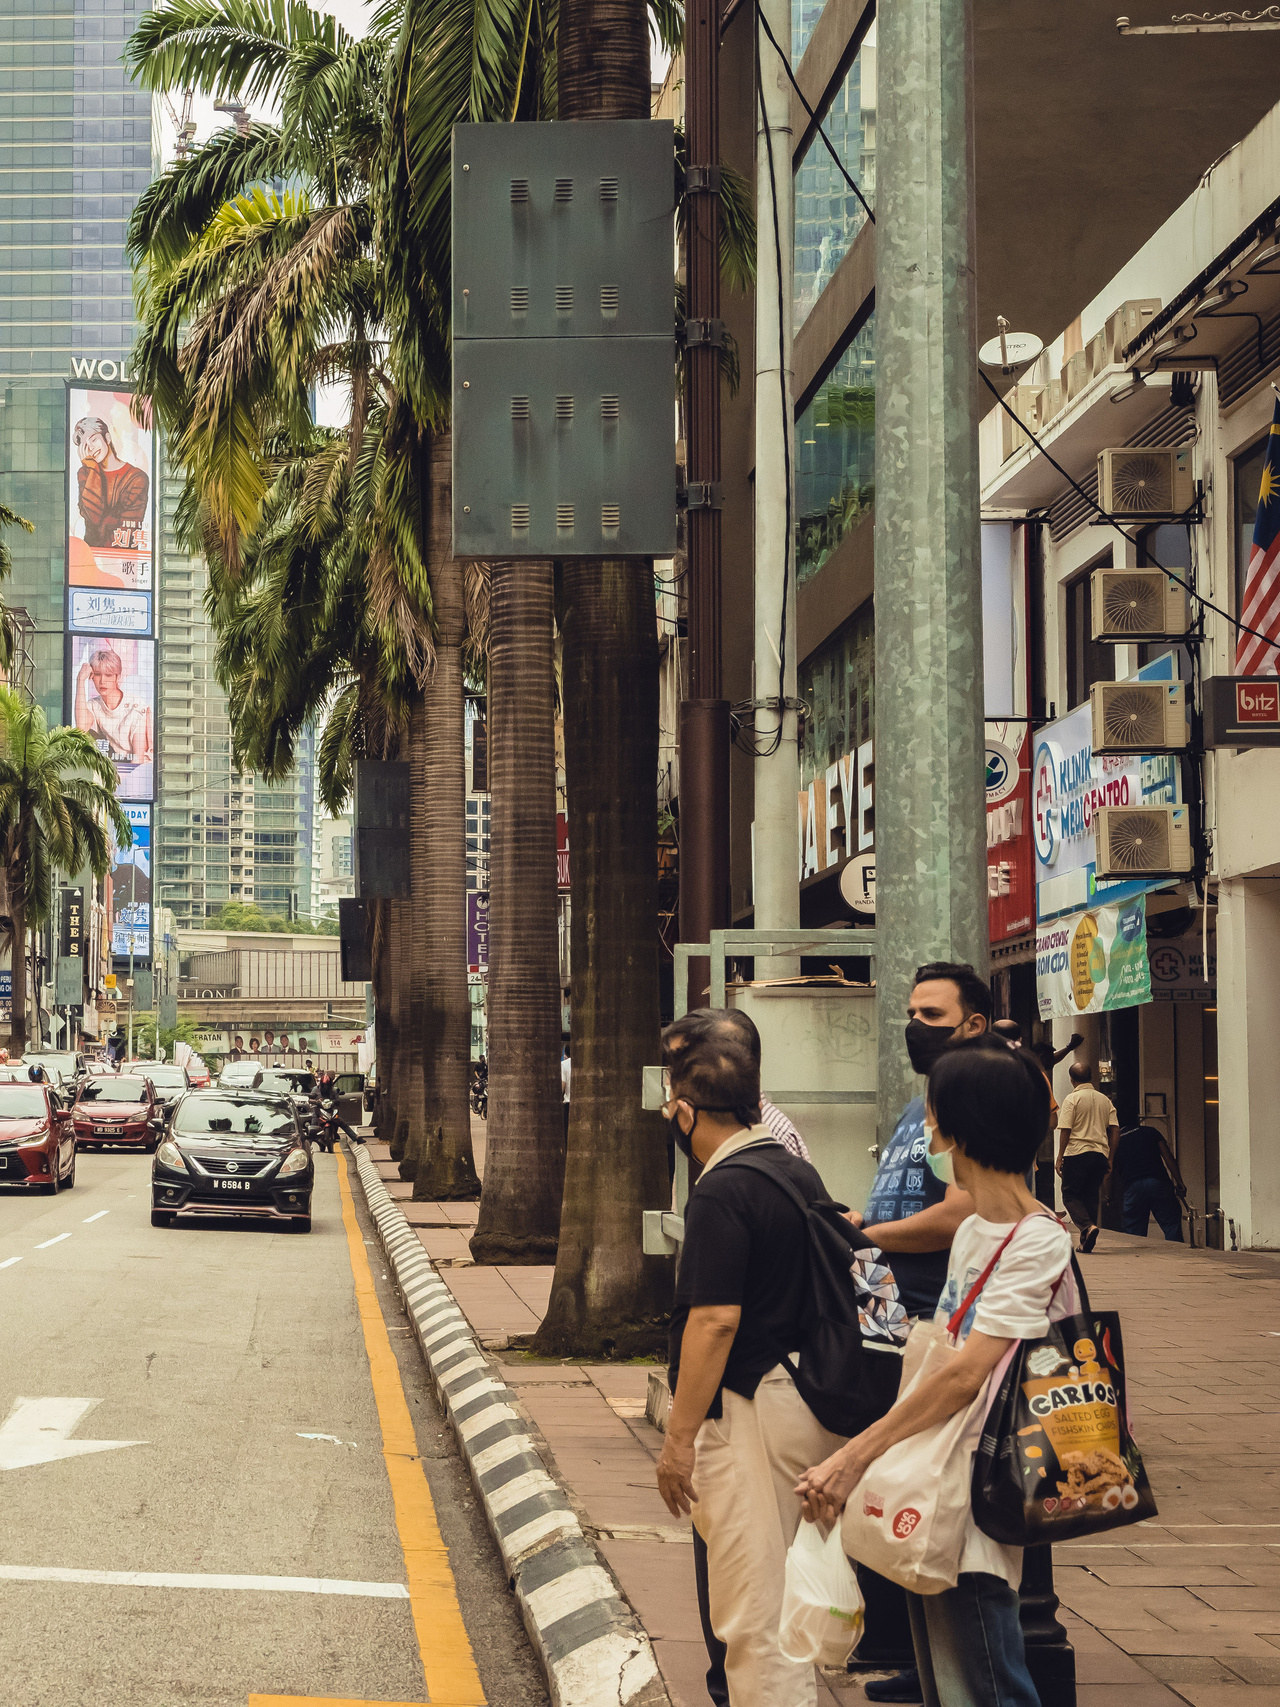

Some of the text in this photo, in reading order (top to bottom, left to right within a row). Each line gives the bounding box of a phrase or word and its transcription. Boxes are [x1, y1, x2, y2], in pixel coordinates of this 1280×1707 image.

[72, 357, 139, 382] WOL
[112, 528, 148, 548] 刘隽
[122, 561, 149, 576] 歌手
[1240, 688, 1274, 710] bitz
[1060, 746, 1091, 794] KLINIK
[124, 810, 148, 818] HDAY
[70, 905, 80, 938] THE
[474, 912, 490, 964] HOTEL
[213, 1180, 219, 1188] W
[222, 1180, 242, 1190] 6584
[1029, 1381, 1116, 1416] CARLOS
[1054, 1408, 1111, 1423] SALTED EGG
[1052, 1424, 1094, 1436] FISHSKIN
[900, 1512, 917, 1525] SG
[896, 1521, 912, 1535] 50
